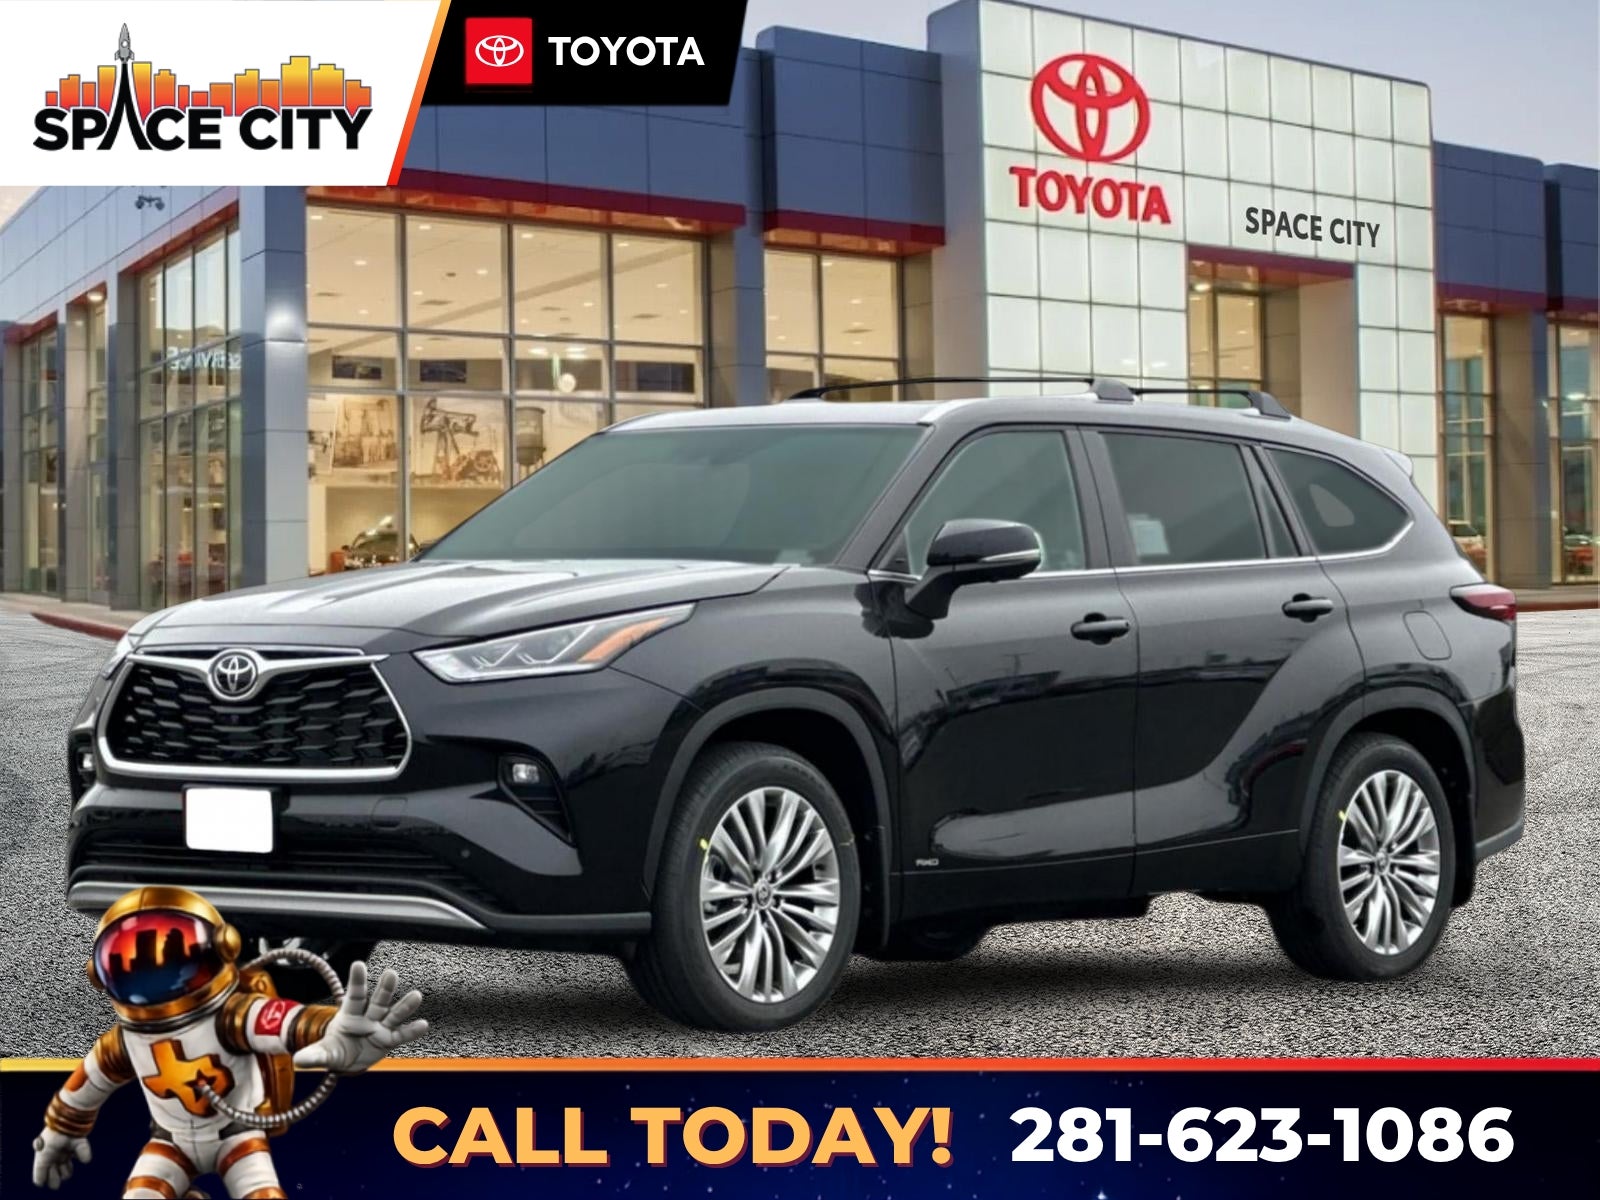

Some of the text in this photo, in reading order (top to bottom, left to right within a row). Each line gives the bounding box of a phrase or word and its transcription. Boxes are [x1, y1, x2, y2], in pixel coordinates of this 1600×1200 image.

[1009, 166, 1171, 224] TOYOTA
[1245, 206, 1381, 248] SPACE CITY
